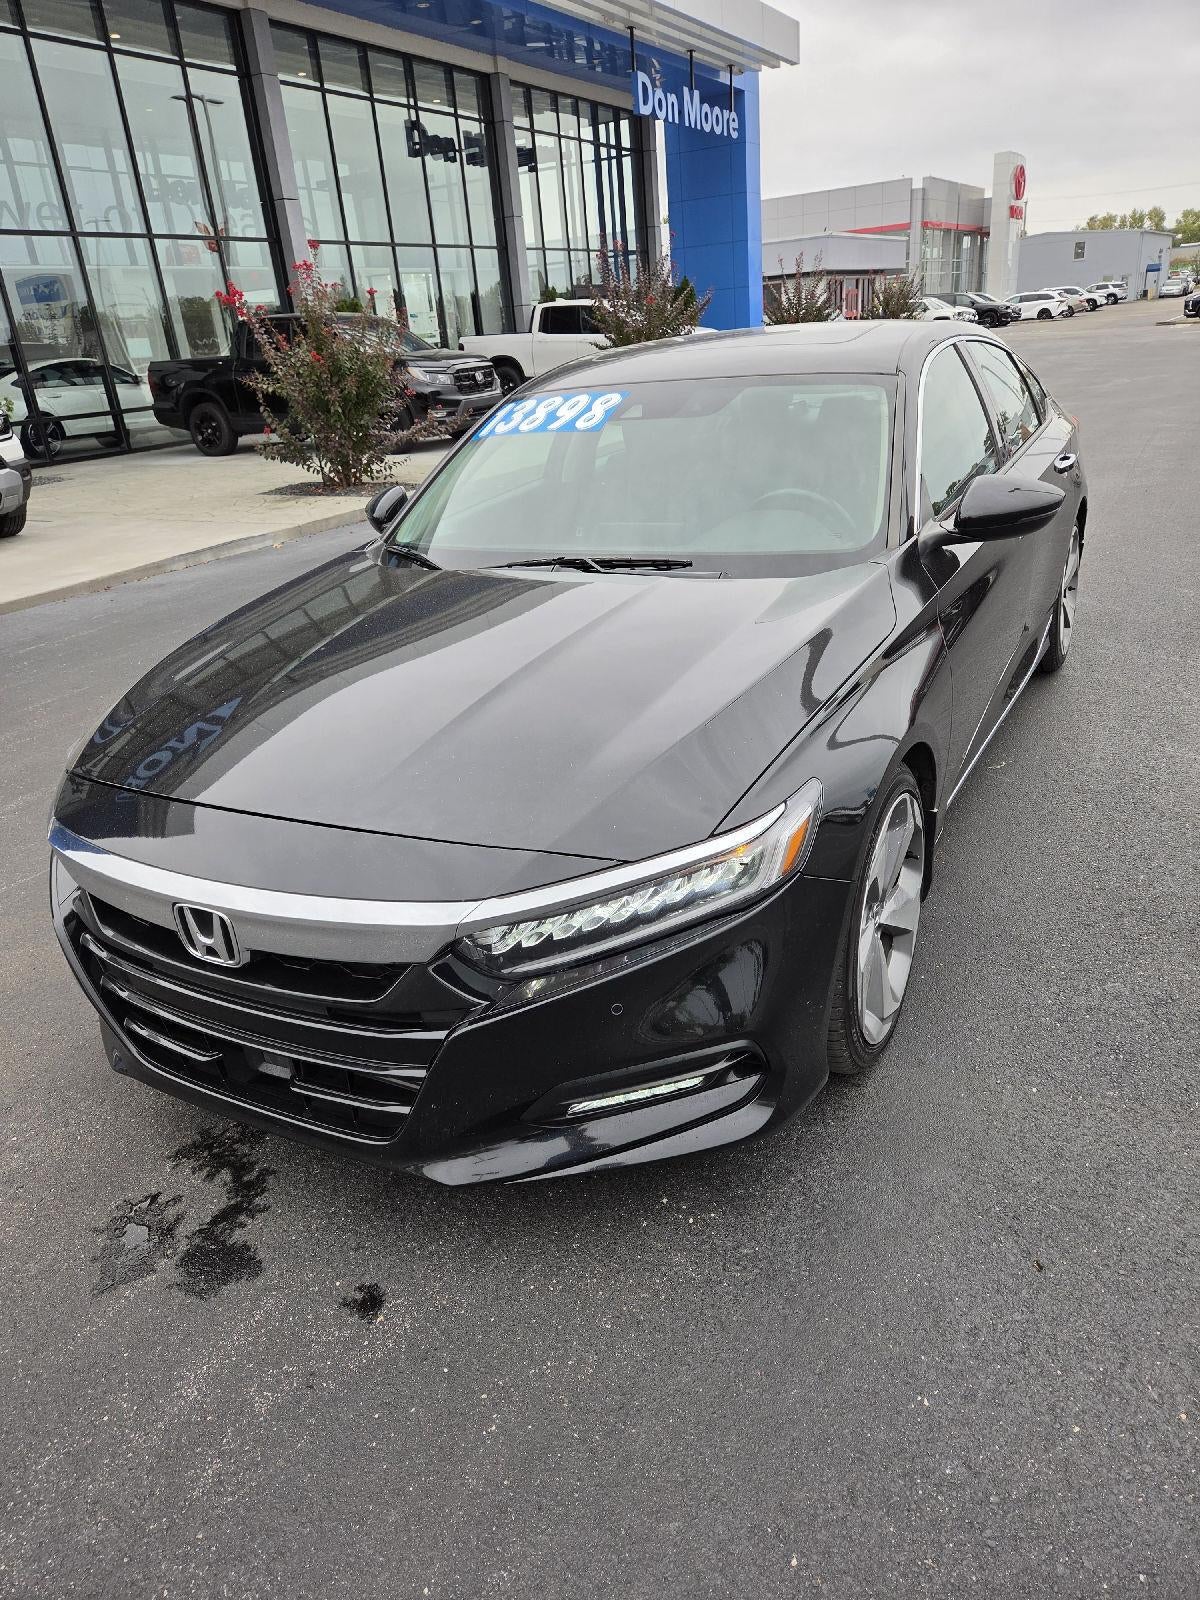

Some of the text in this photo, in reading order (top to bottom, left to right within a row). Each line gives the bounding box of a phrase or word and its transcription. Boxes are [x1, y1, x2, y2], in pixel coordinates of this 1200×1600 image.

[636, 70, 739, 139] Don Moore
[478, 392, 623, 437] 13898
